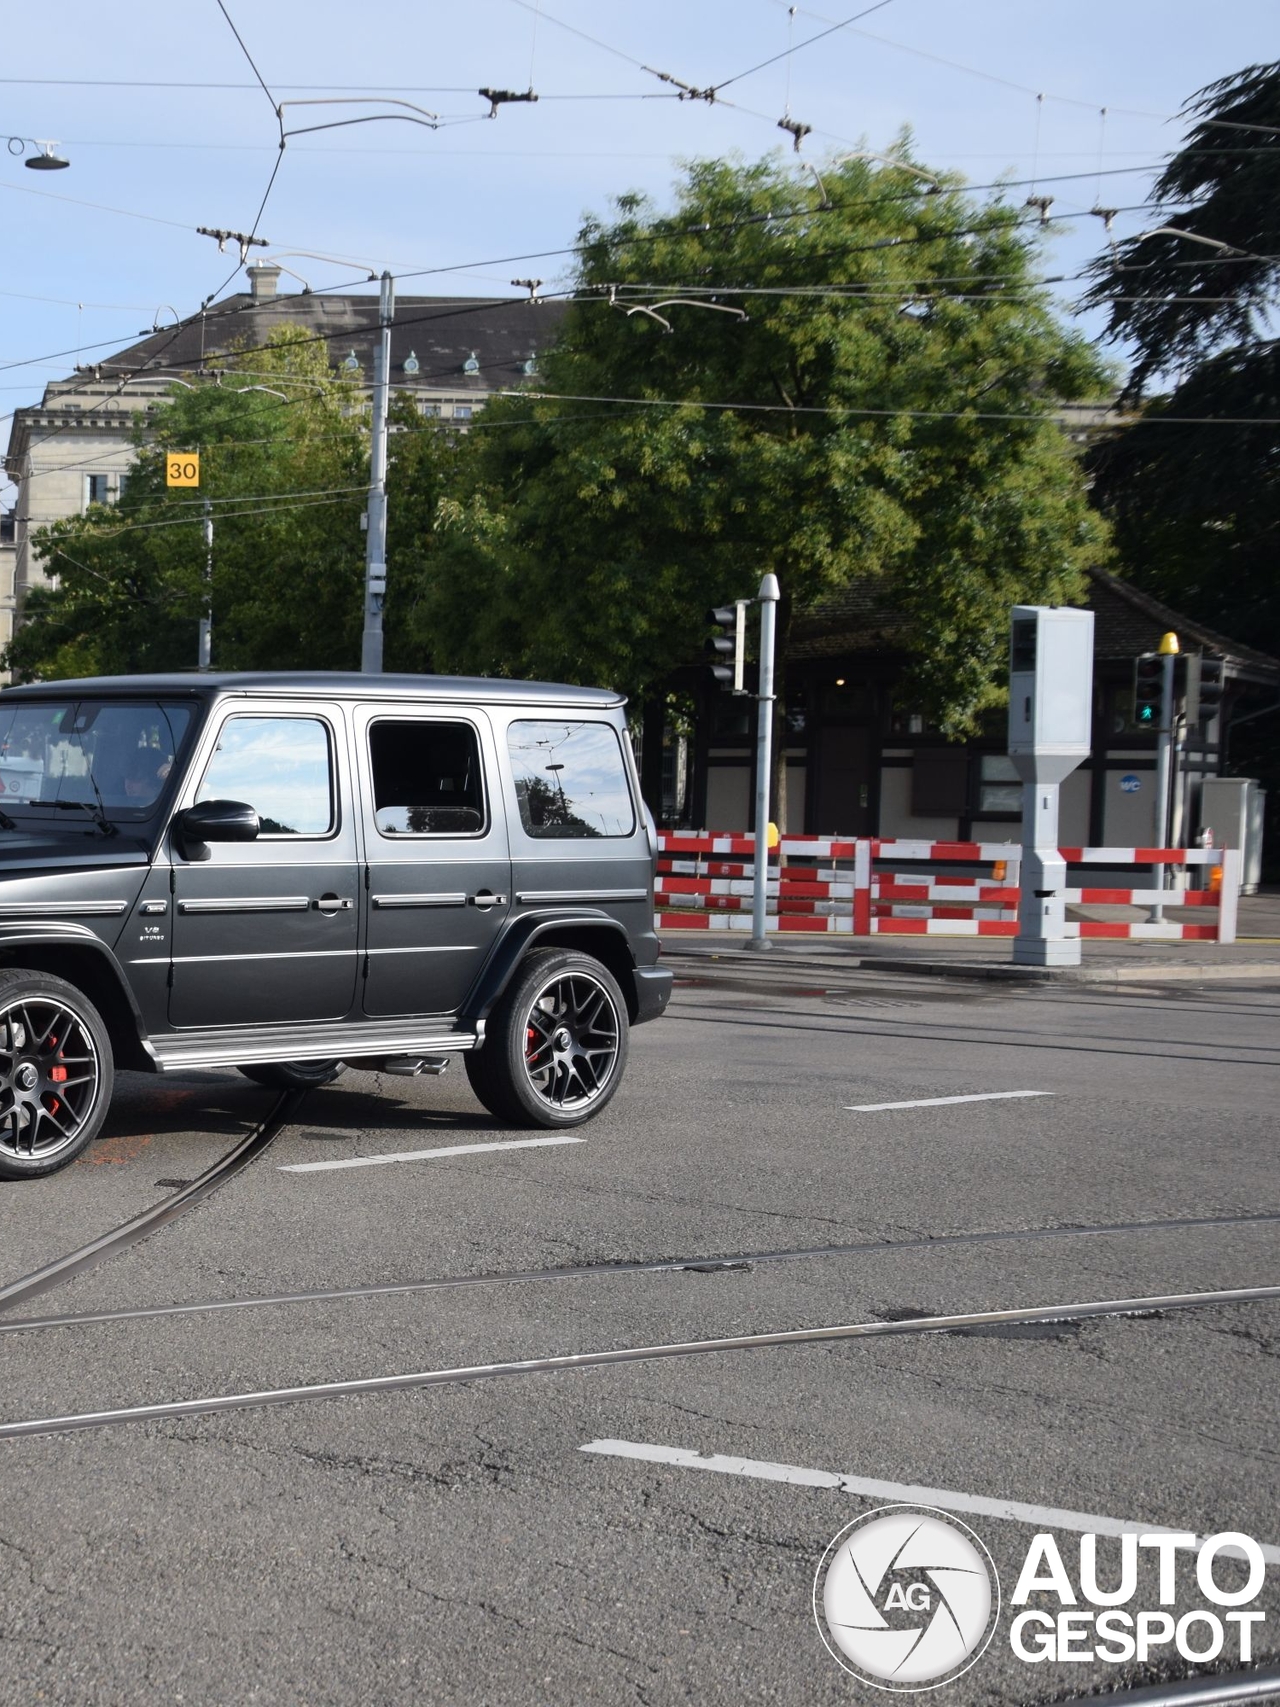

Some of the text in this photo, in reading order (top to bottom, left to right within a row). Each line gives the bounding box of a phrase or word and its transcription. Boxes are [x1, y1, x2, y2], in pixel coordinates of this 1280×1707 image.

[170, 462, 197, 480] 30
[1119, 780, 1141, 792] WC
[144, 926, 160, 934] V8
